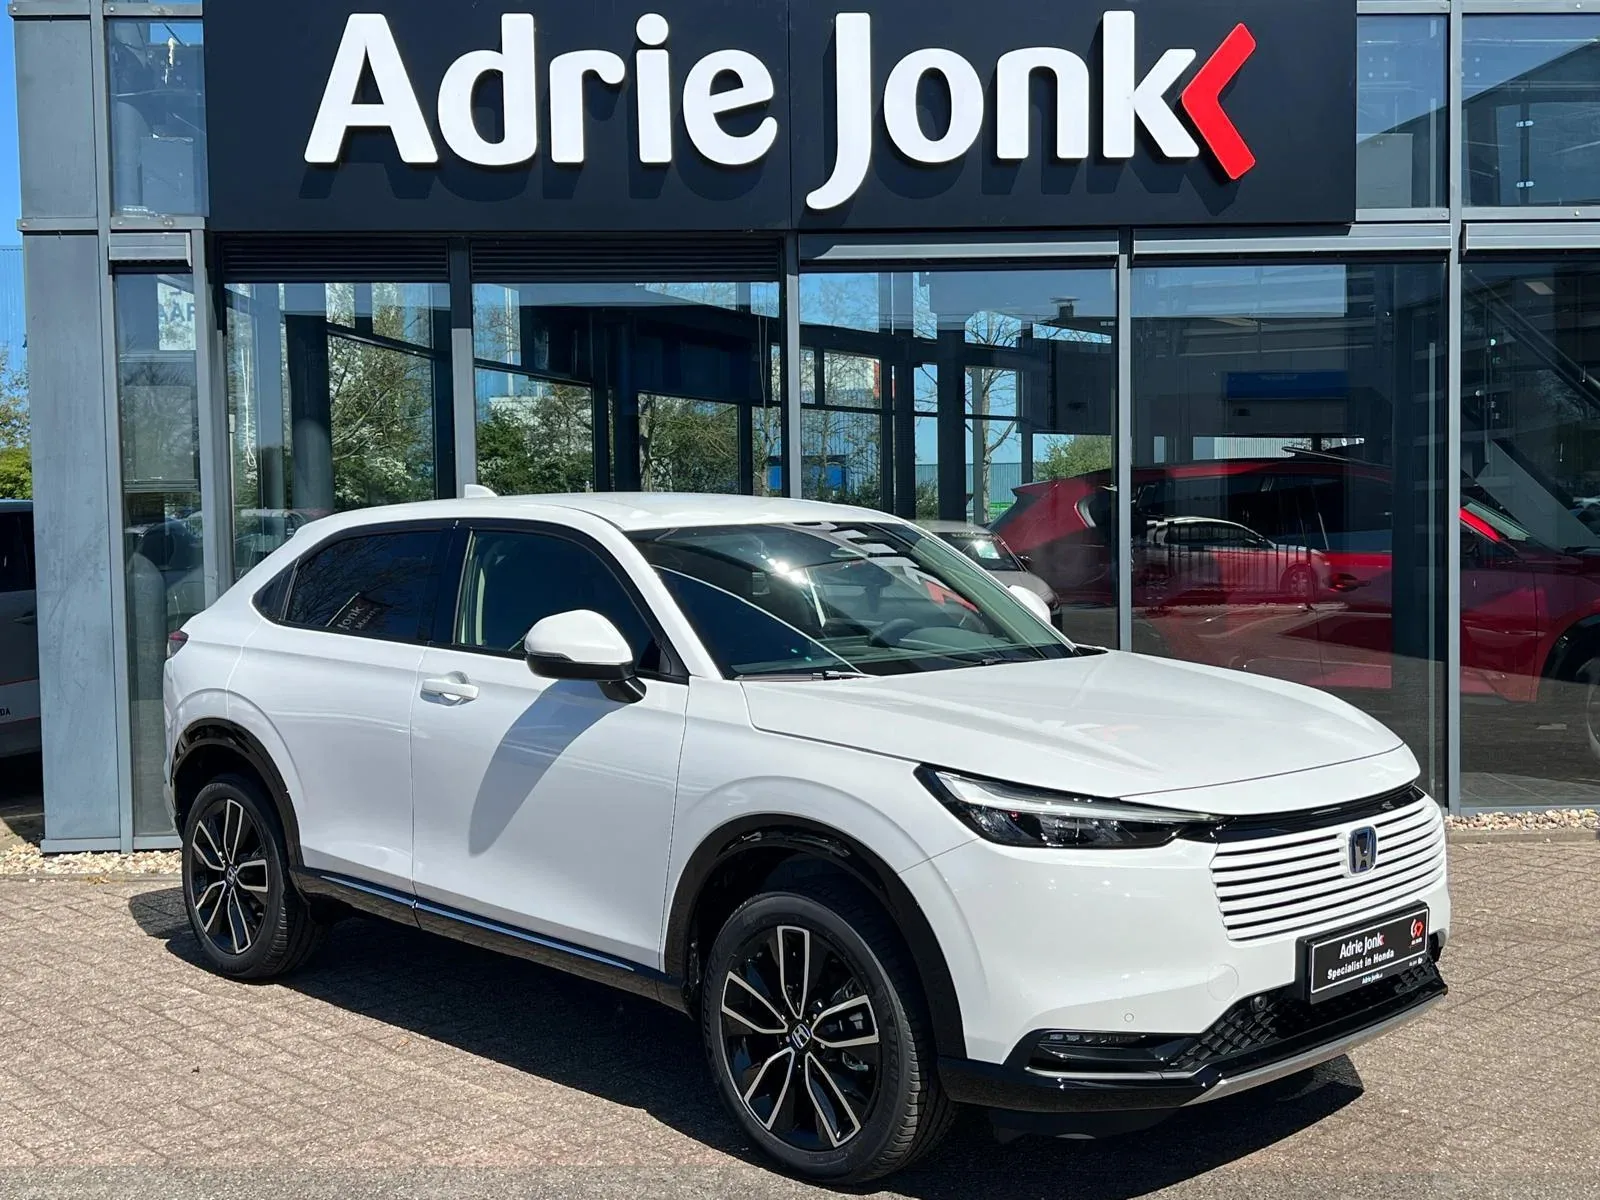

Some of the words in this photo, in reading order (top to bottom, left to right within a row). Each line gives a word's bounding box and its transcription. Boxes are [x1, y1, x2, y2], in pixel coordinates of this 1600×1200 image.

[304, 13, 778, 165] Adrie
[806, 10, 1200, 210] Jonk
[0, 707, 11, 717] DA
[1339, 940, 1363, 959] Adrie
[1362, 932, 1384, 955] Jonk
[1327, 959, 1363, 980] Specialist
[1364, 956, 1372, 967] in
[1373, 949, 1395, 963] Honda
